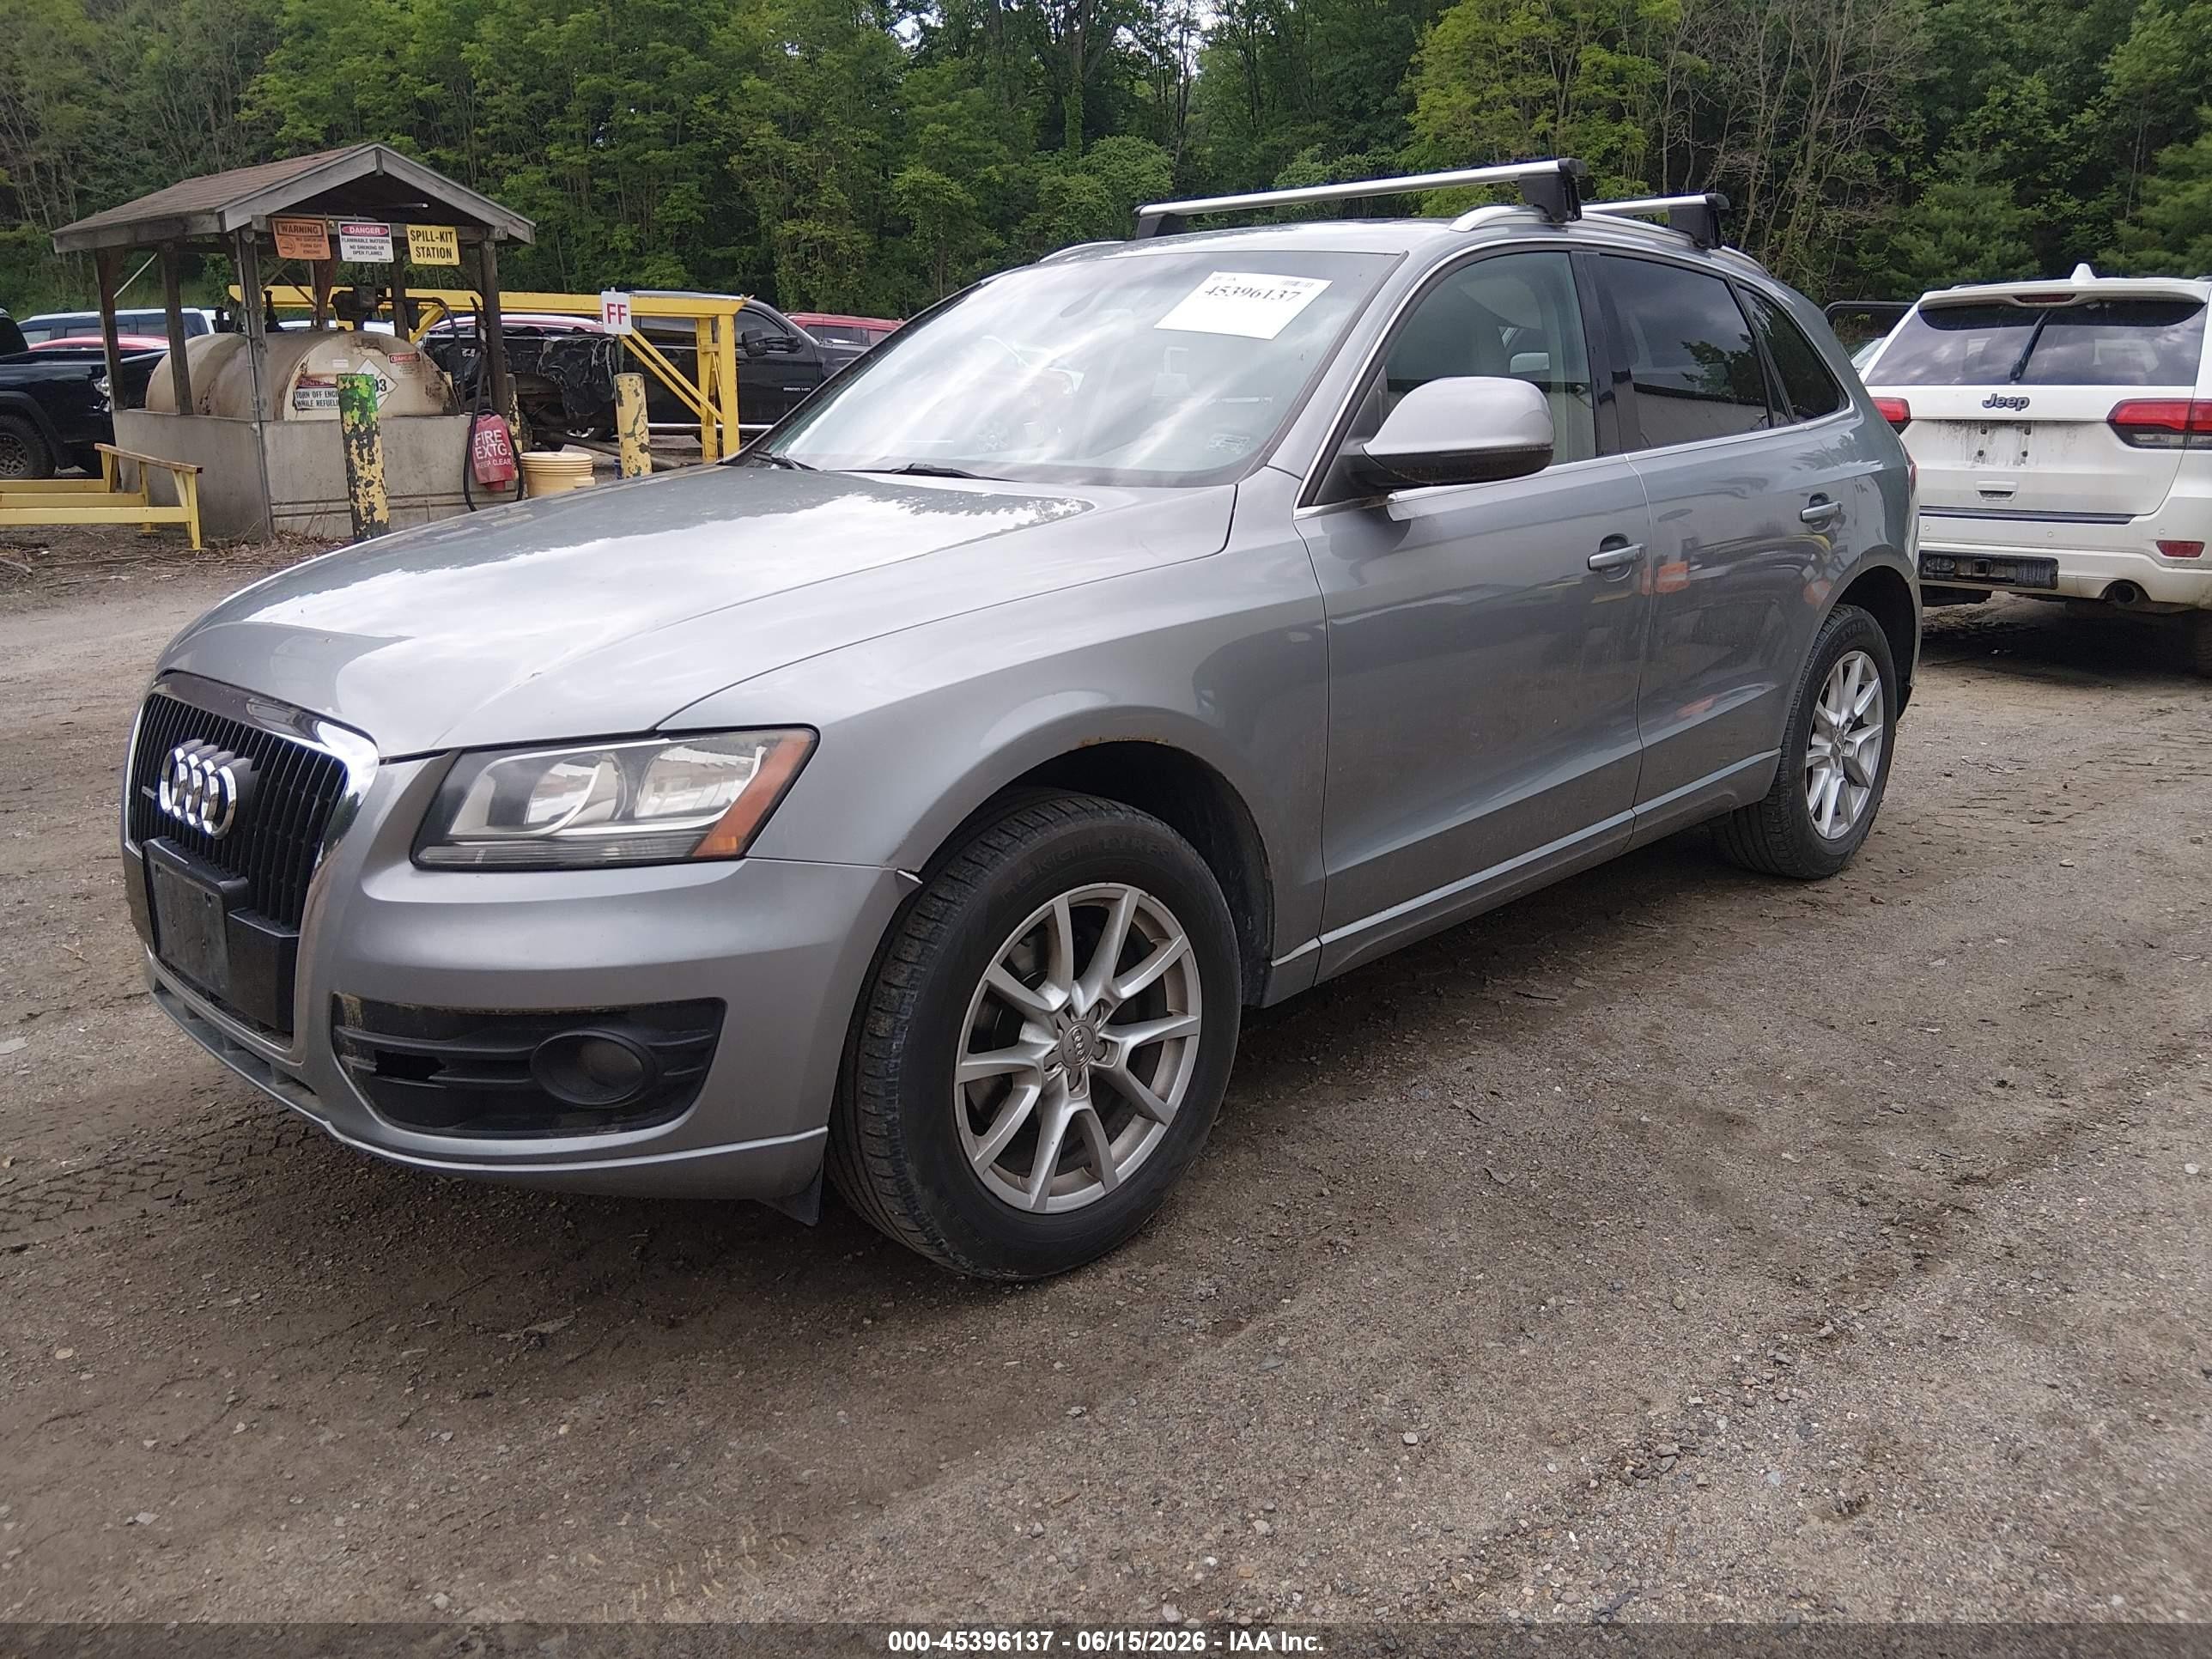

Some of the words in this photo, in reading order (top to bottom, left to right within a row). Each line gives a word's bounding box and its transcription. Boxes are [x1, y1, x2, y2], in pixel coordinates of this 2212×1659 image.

[281, 224, 319, 234] WARNING
[349, 226, 381, 234] DANGER
[410, 229, 453, 243] SPILL-KIT
[415, 246, 453, 259] STATION
[1205, 286, 1302, 301] 45396137
[607, 302, 627, 325] FF
[1982, 393, 2030, 411] Jeep
[475, 429, 503, 447] FIRE
[475, 442, 512, 460] EXTG.
